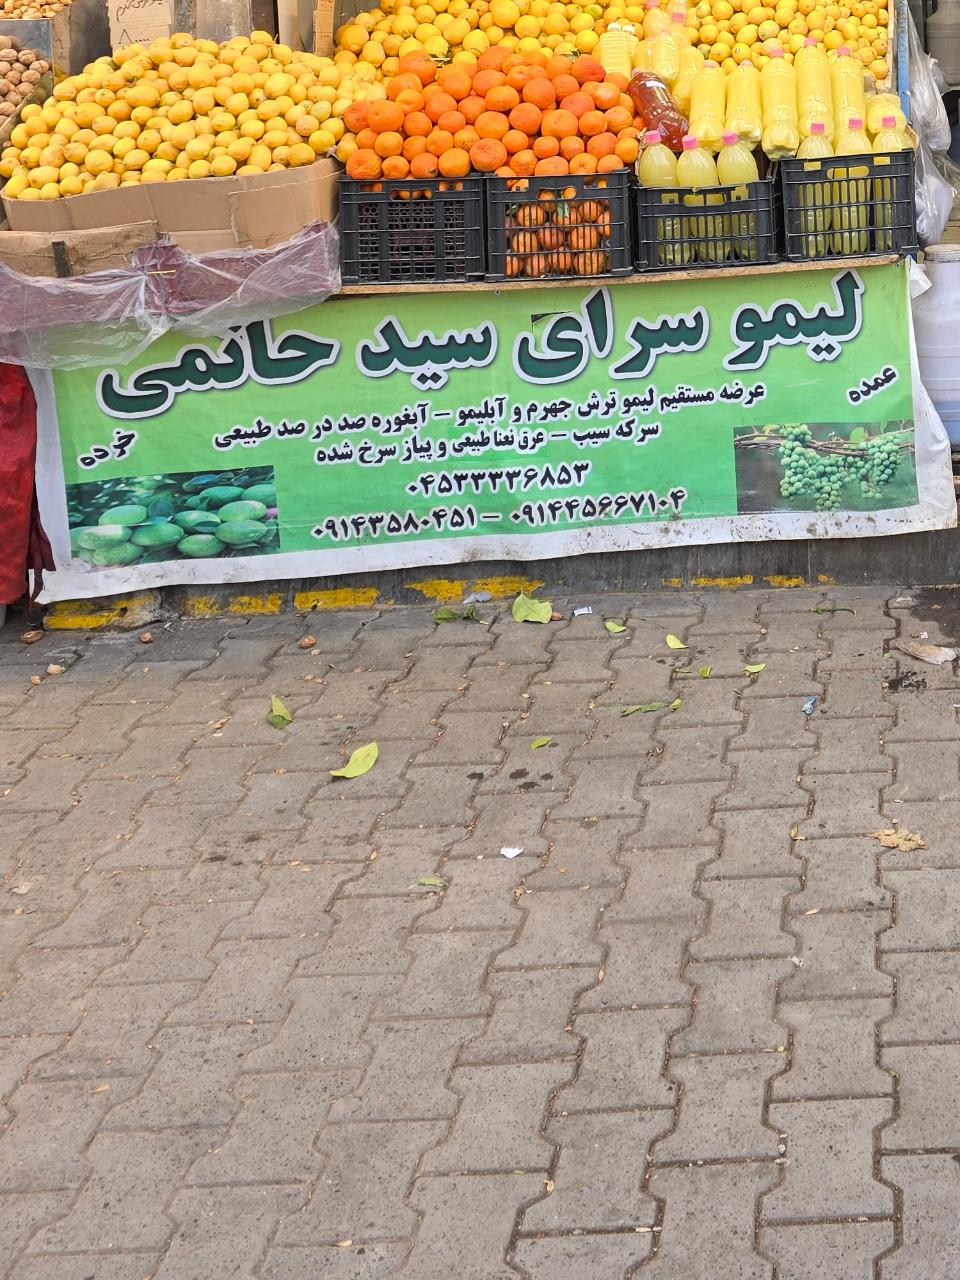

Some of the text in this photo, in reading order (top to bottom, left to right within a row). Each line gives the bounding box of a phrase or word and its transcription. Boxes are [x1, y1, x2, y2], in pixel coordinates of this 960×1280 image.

[96, 267, 865, 419] لیمو سرای سید حاتمی
[846, 363, 898, 407] عمده
[213, 381, 766, 450] عرضه مستقیم لیمو ترش جهرم و آبلیمو آبغوره صد در صد طبیعی
[78, 429, 139, 470] خرده
[316, 419, 660, 465] سرکه سیب عرق نعنا طبیعی و پیاز سرخ شده
[406, 460, 593, 498] ۰۴۵۳۳۳۳۶۸۵۳
[311, 487, 688, 541] ۰۹۱۴۳۵۸۰۴۵۱ ۰۹۱۴۴۵۶۶۷۱۰۴
